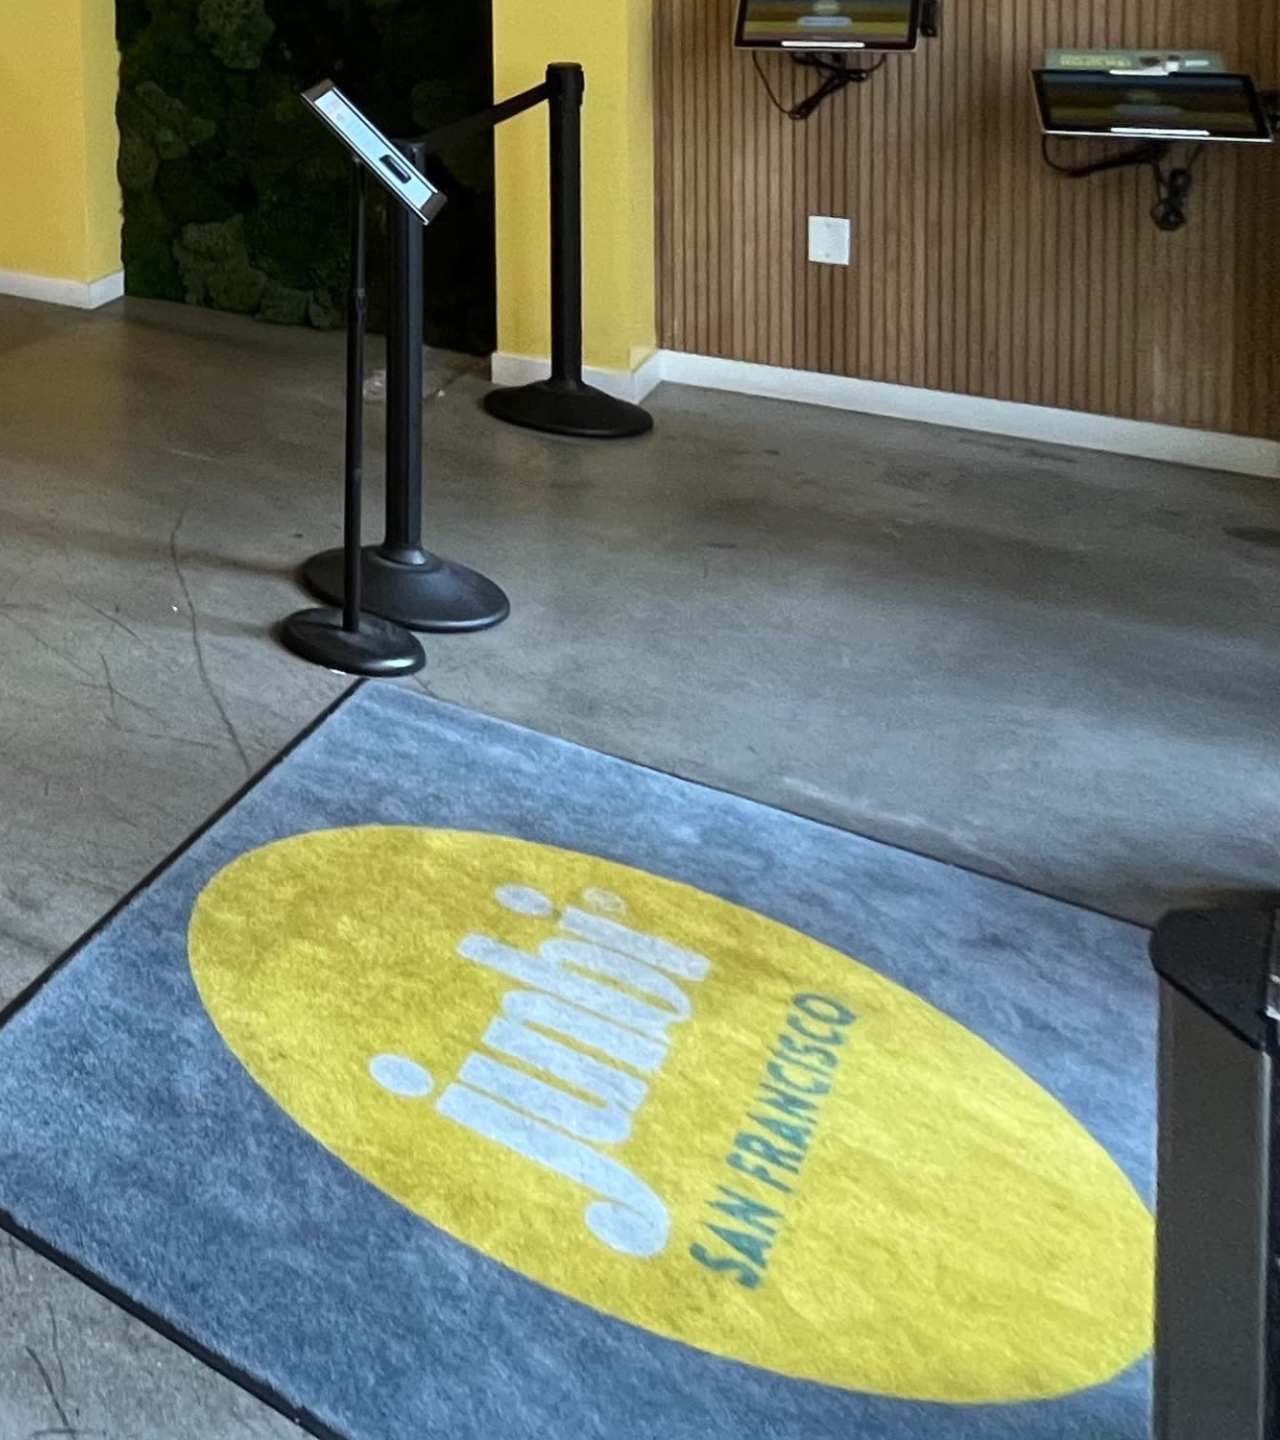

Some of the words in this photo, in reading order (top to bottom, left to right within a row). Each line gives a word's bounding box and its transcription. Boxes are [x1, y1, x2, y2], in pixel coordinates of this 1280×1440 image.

[368, 883, 711, 1259] junbi
[726, 992, 857, 1195] FRANCISCO
[688, 1185, 785, 1291] SAN
